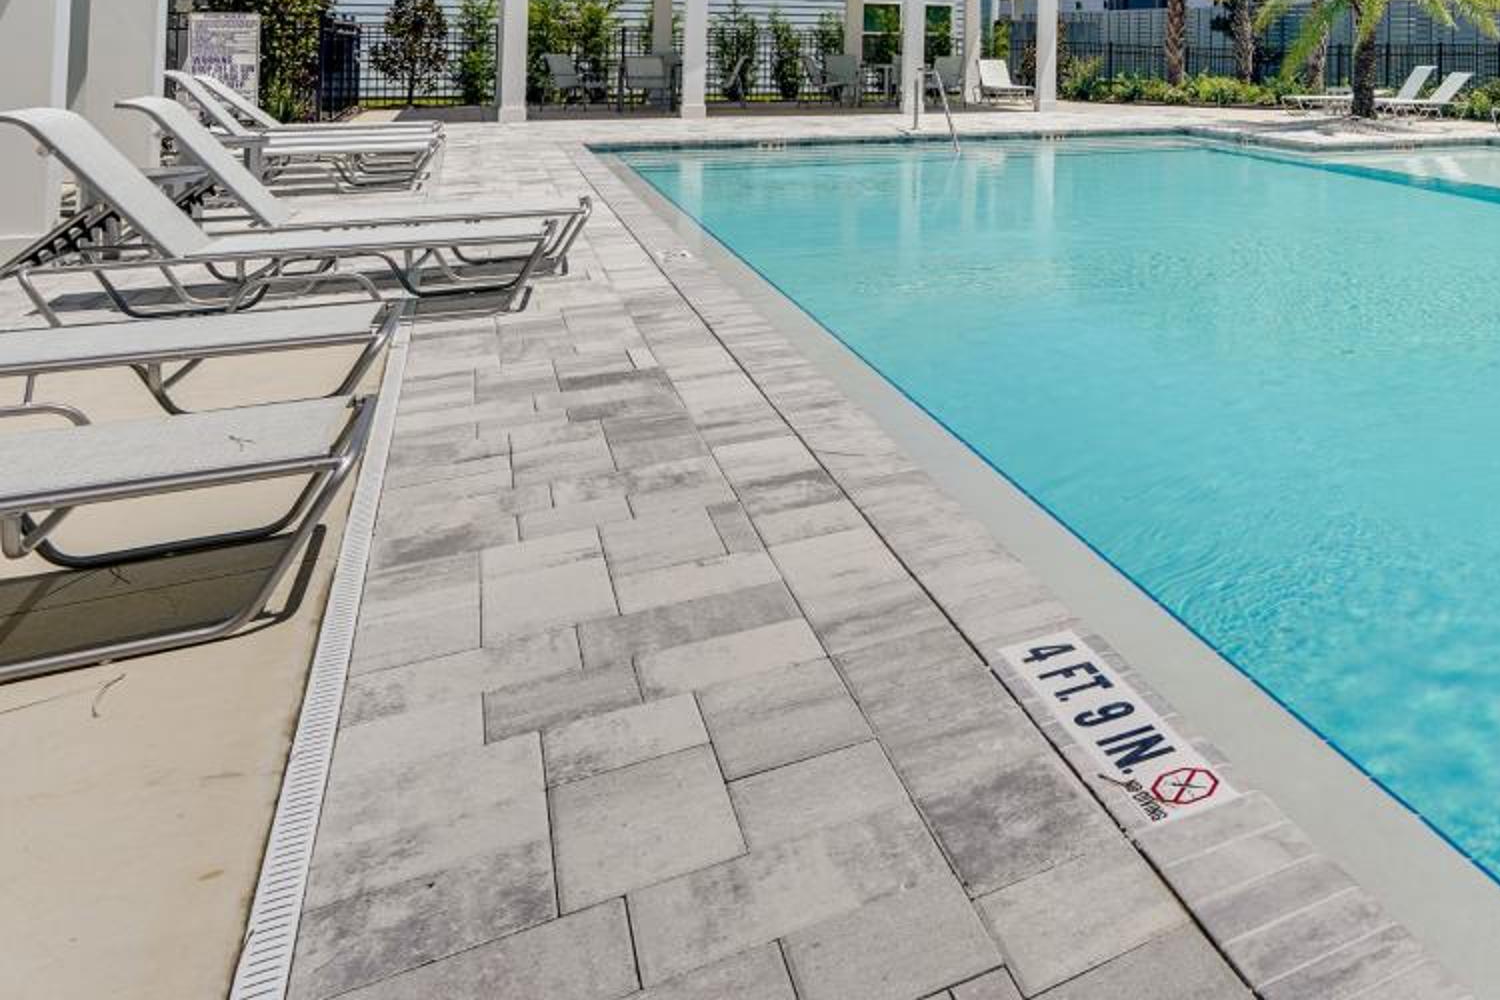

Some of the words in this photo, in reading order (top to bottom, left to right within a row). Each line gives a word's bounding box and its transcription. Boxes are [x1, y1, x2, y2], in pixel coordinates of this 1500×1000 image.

[1022, 643, 1077, 663] 4
[1037, 661, 1114, 701] FT.
[1073, 701, 1136, 728] 9
[1095, 724, 1177, 775] IN.
